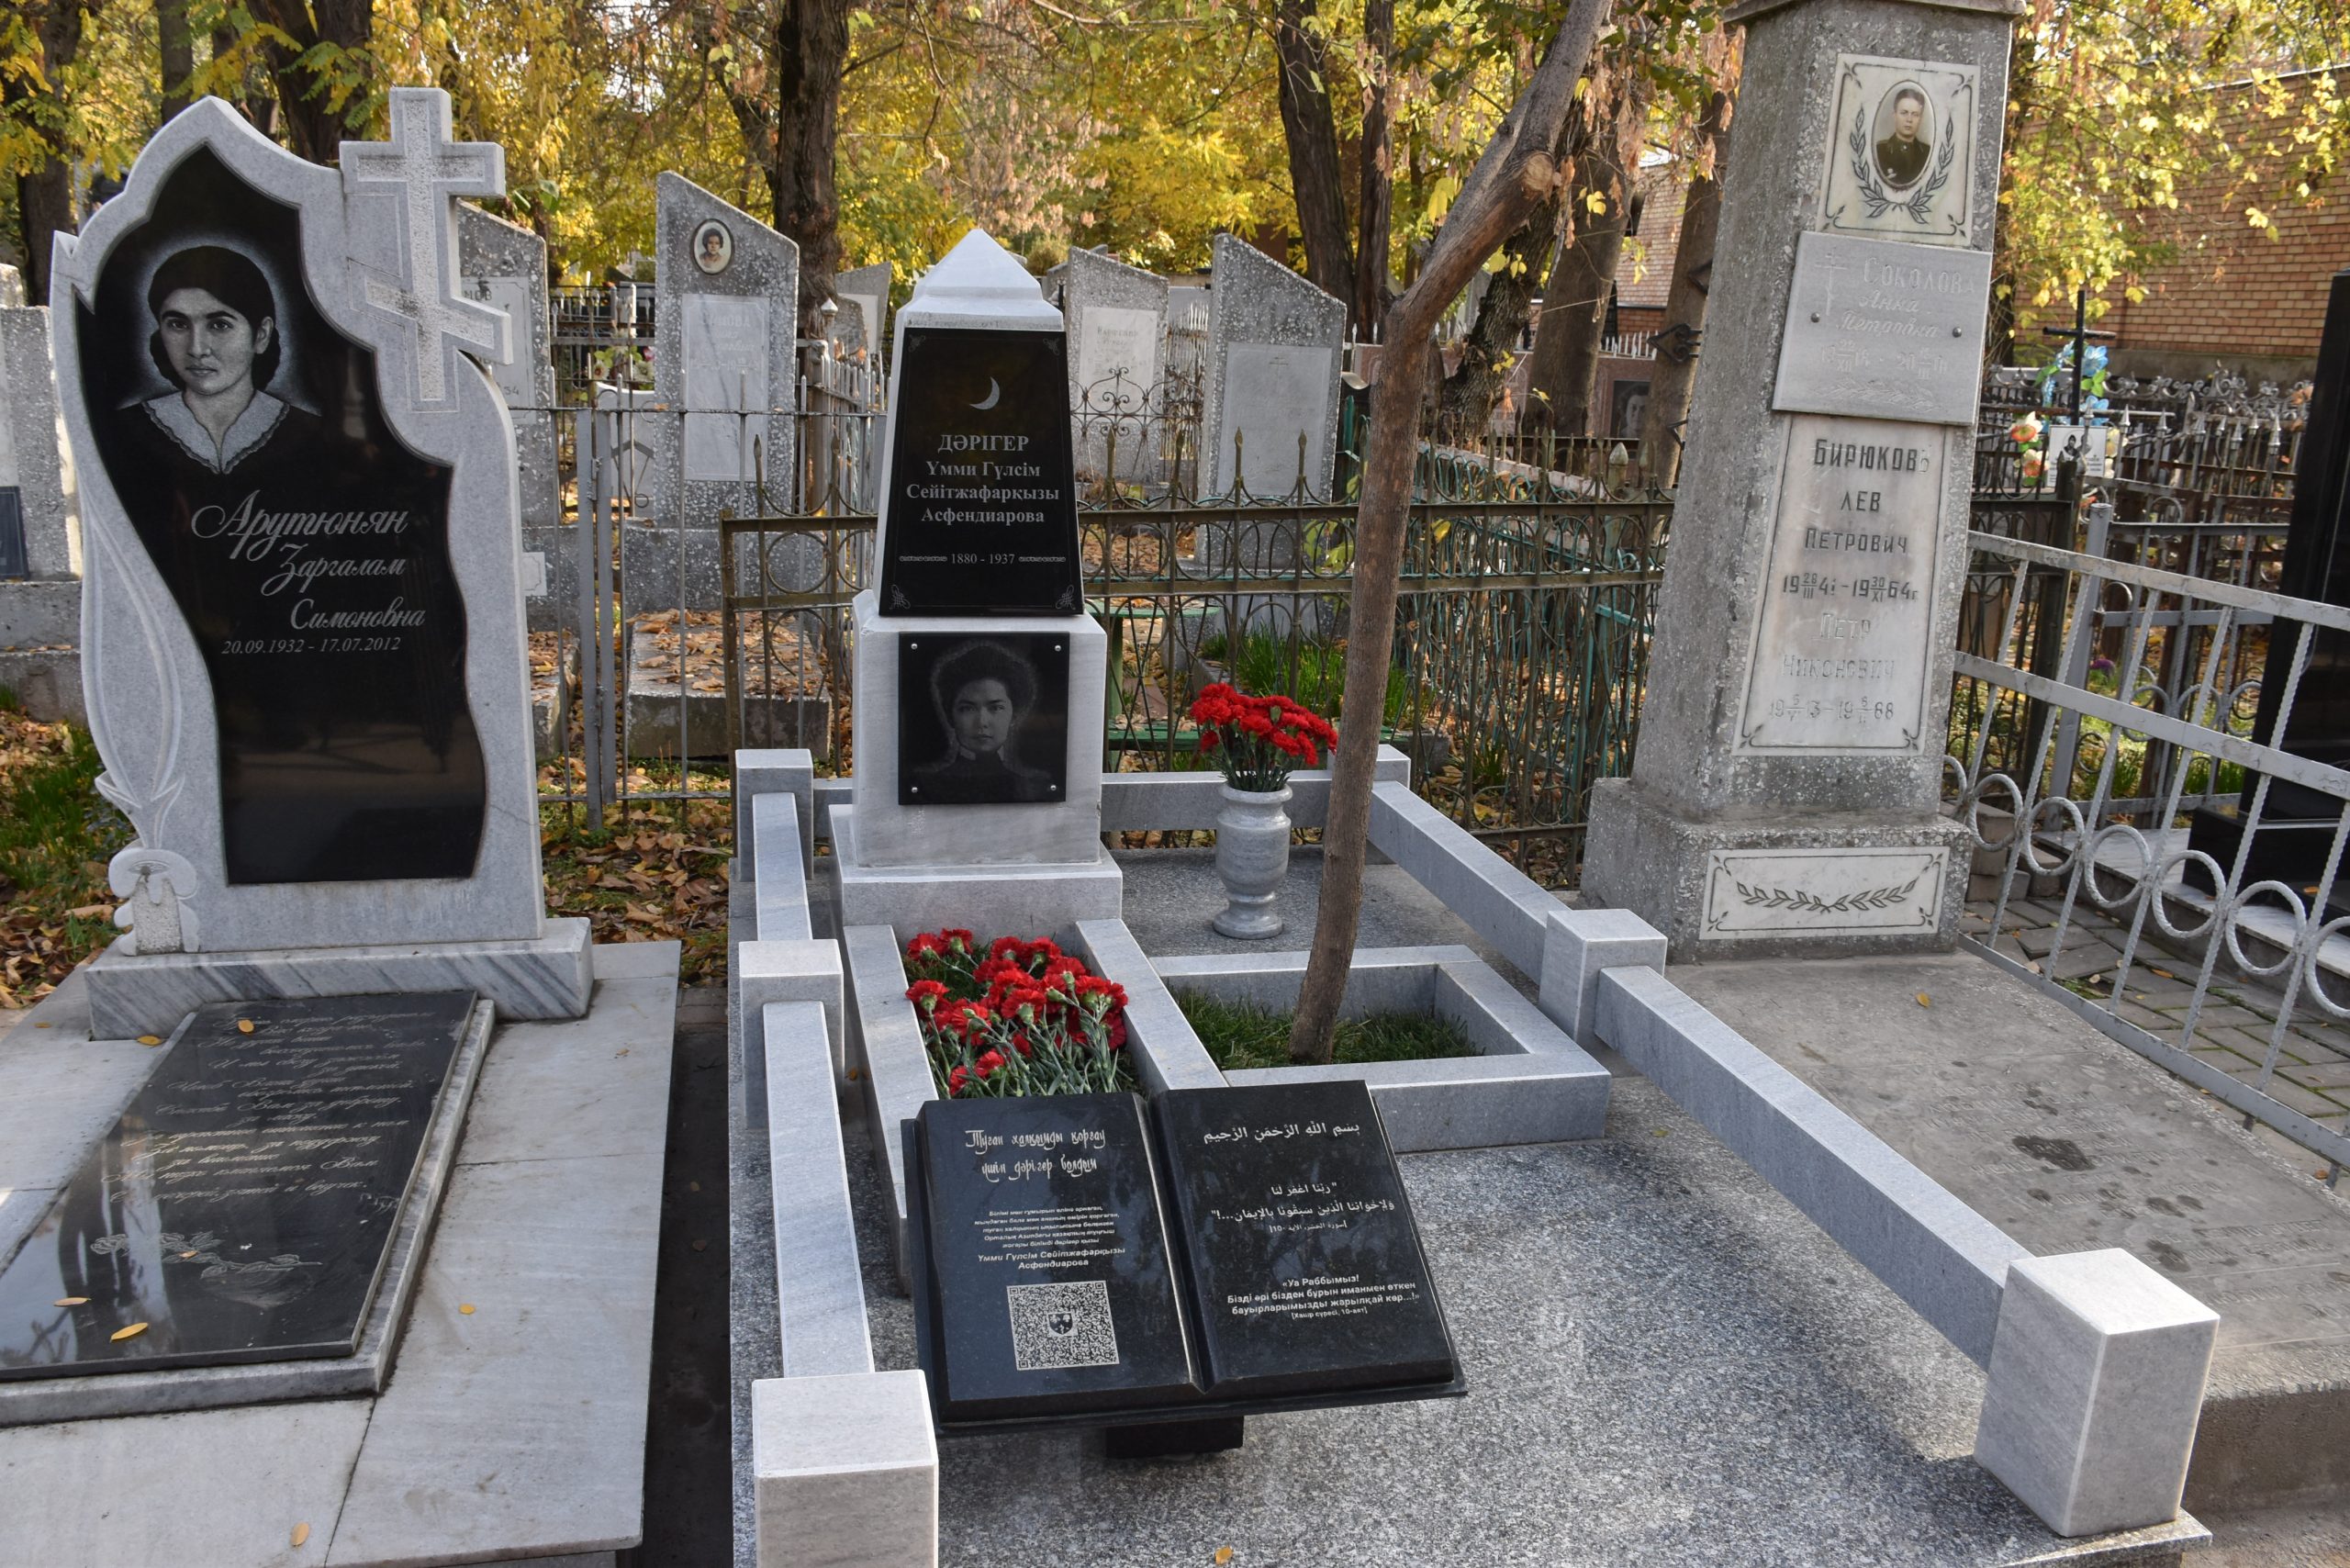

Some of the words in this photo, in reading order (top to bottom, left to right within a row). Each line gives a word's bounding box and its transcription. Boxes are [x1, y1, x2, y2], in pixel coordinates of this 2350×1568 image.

[1859, 290, 1919, 312] Анна
[1842, 310, 1939, 338] Петровна
[938, 435, 1029, 454] ДӘРІГЕР
[926, 460, 977, 477] Үмми
[982, 462, 1040, 480] Гүлсім
[906, 484, 1059, 502] Сейітжафарқызы
[1841, 491, 1881, 511] ЛЕВ
[191, 489, 408, 561] Арутюнян
[922, 508, 1044, 526] Асфендиарова
[1806, 528, 1907, 553] ПЕТРОВИЧ
[261, 543, 407, 596] Заргалам
[952, 554, 977, 564] 1880
[990, 554, 1014, 565] 1937
[290, 597, 426, 629] Симоновна
[1820, 612, 1871, 639] ПЕТР
[222, 640, 304, 655] 20.09.1932
[320, 637, 401, 652] 17.07.2012
[1782, 655, 1895, 678] НИКОНОВИЧ
[978, 1253, 1003, 1262] Үмми
[1006, 1251, 1037, 1261] Гүлсім
[1018, 1259, 1088, 1271] Асфендиарова
[1282, 1279, 1299, 1287] «Уа
[1302, 1275, 1359, 1286] Раббымыз!
[1227, 1294, 1251, 1304] Бізді
[1255, 1294, 1269, 1302] әрі
[1271, 1291, 1304, 1301] бізден
[1307, 1288, 1338, 1297] бұрын
[1341, 1285, 1384, 1294] иманмен
[1388, 1283, 1416, 1292] өткен
[1232, 1302, 1327, 1316] бауырларымызды
